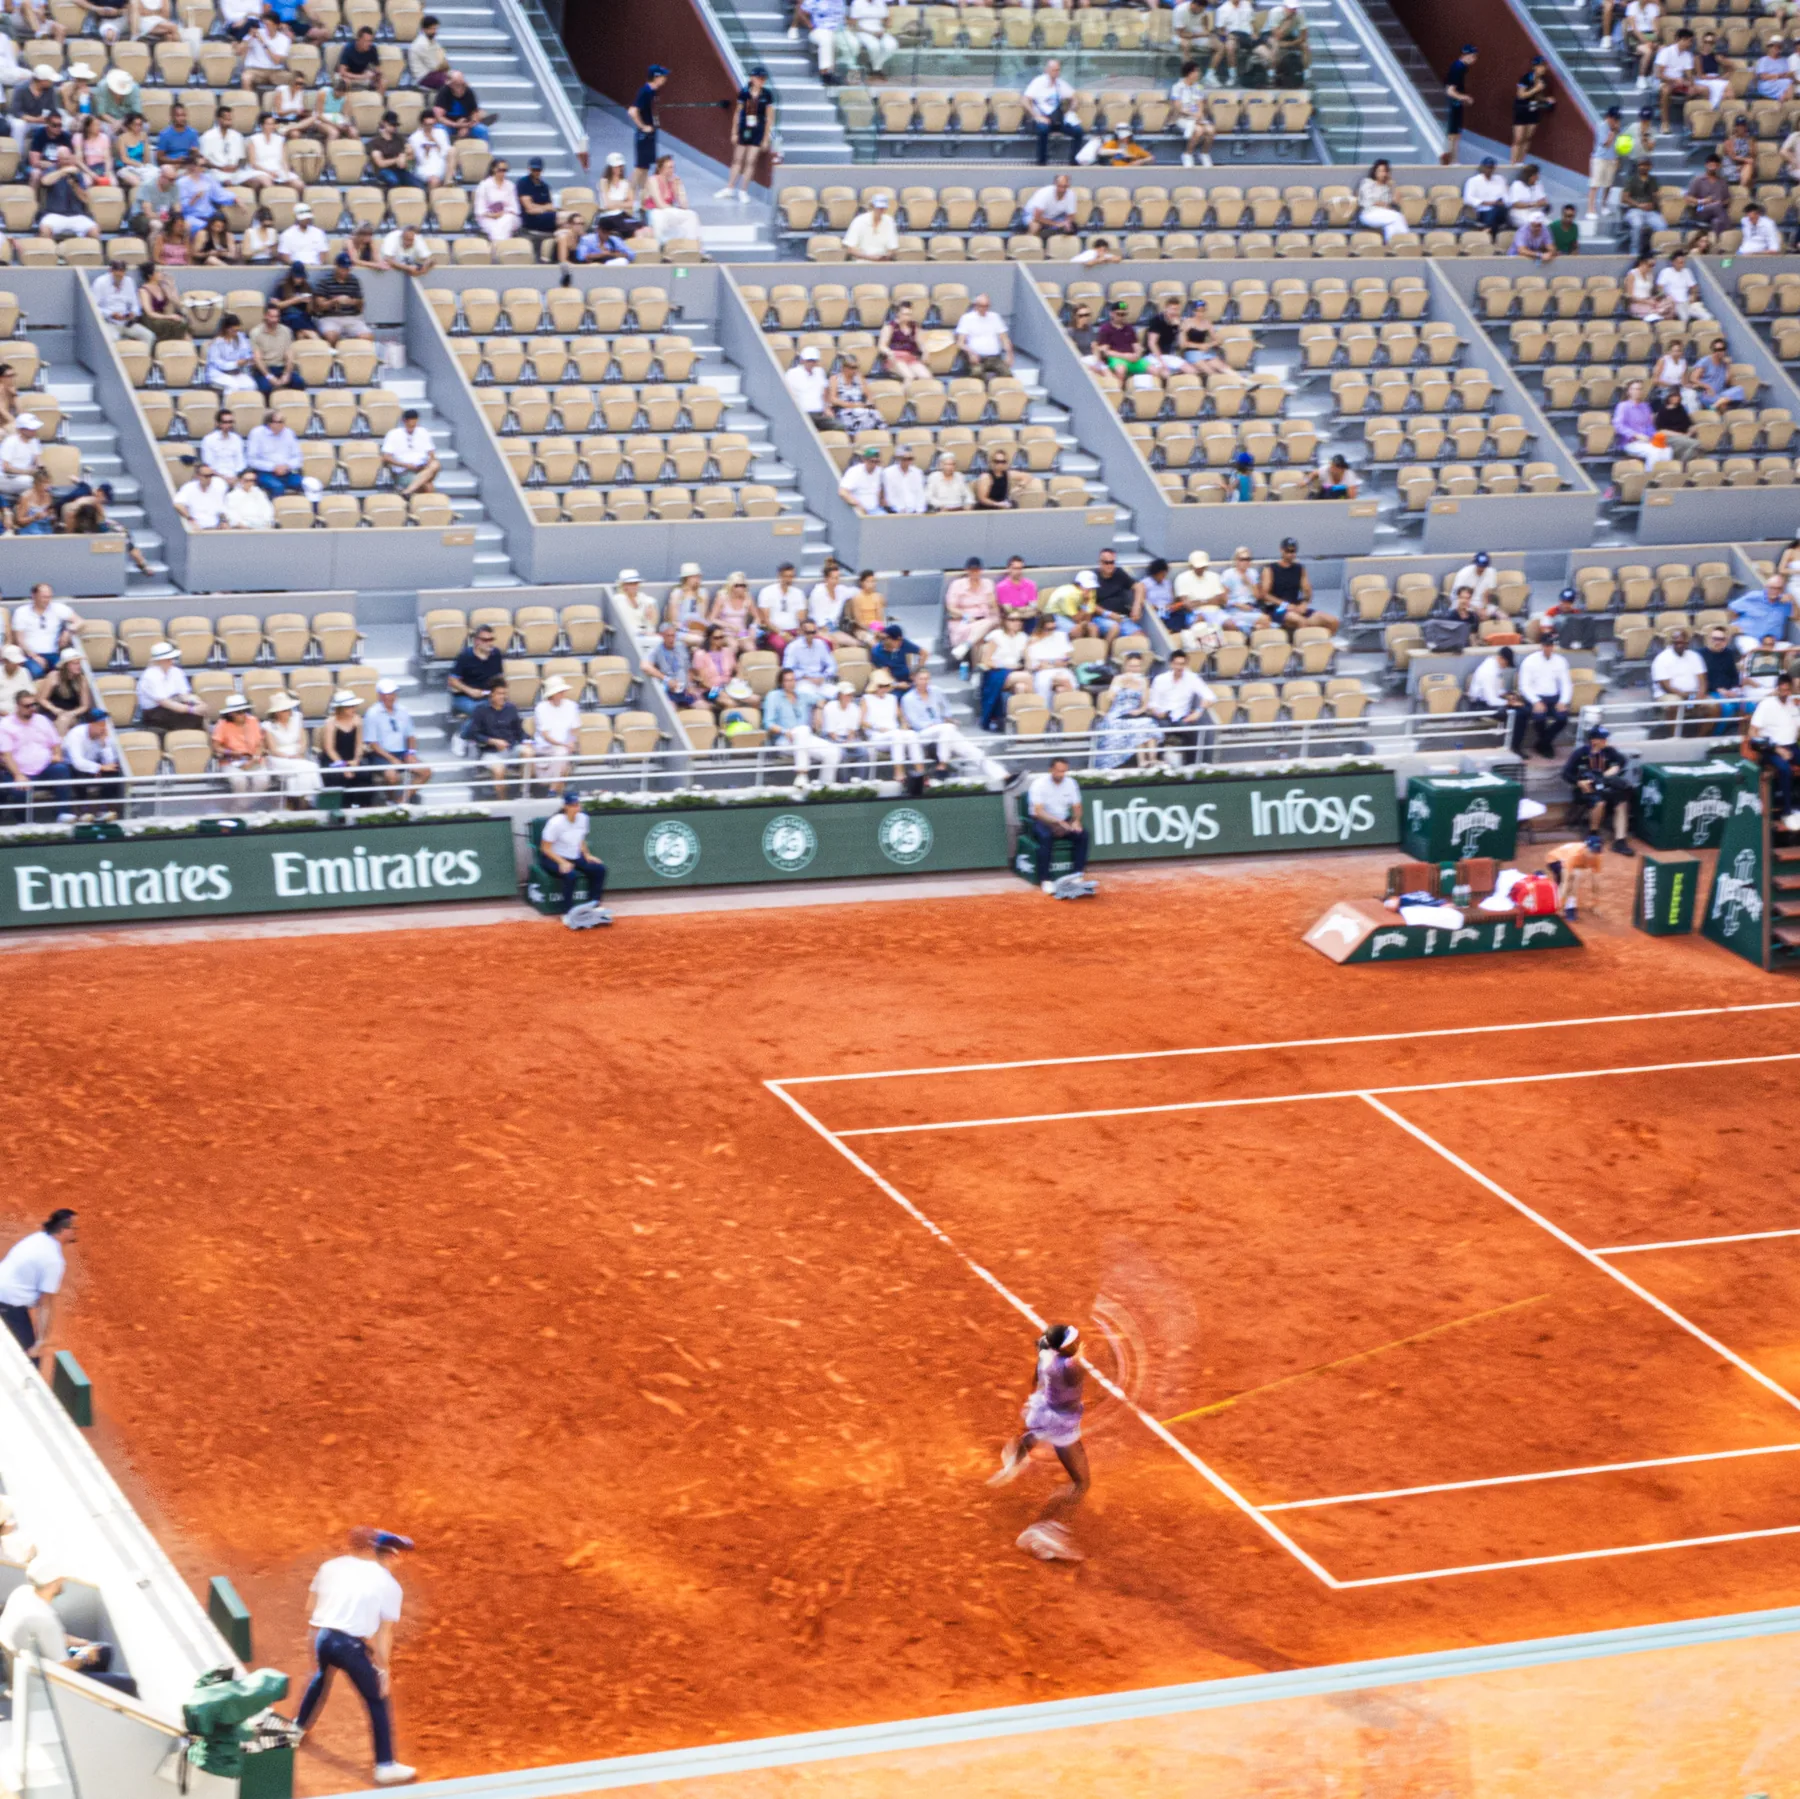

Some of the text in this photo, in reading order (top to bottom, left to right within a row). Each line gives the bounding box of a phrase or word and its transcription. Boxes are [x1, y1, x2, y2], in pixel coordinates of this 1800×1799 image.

[1092, 797, 1220, 849] Infosys
[1251, 788, 1376, 840] Infosys
[14, 846, 482, 912] Emirates Emirates
